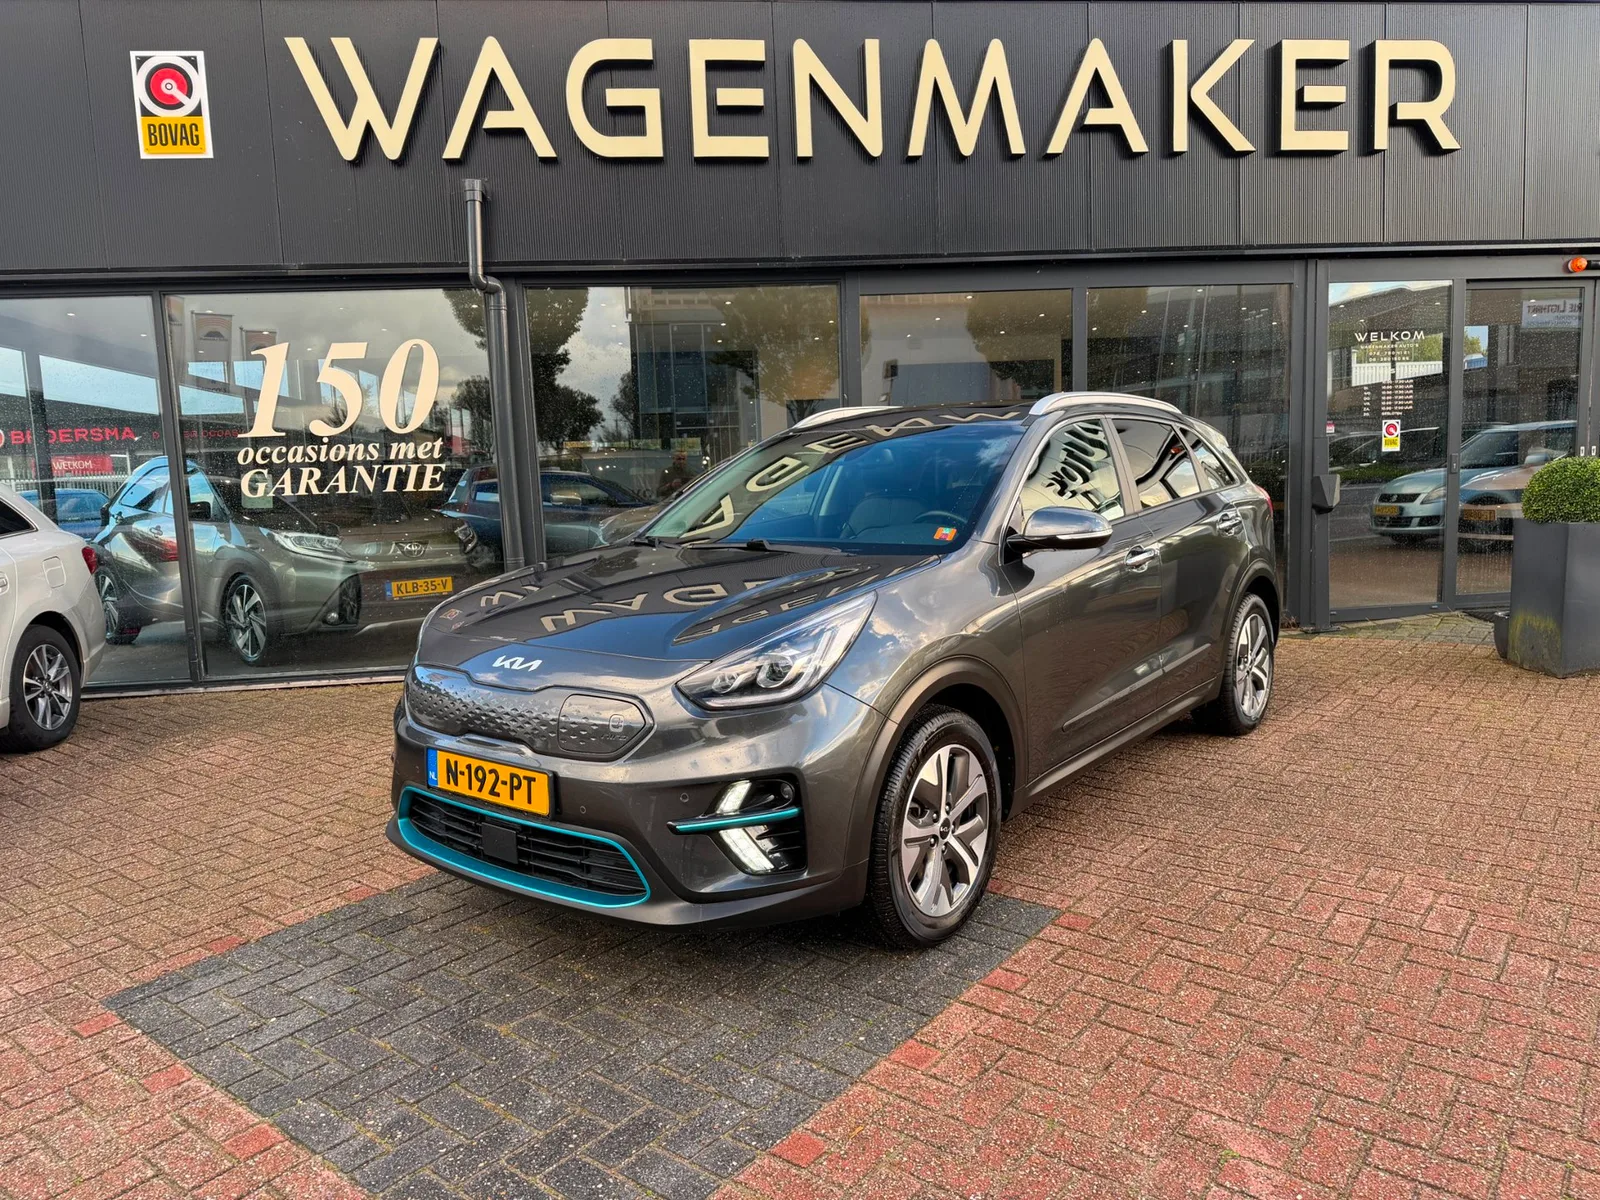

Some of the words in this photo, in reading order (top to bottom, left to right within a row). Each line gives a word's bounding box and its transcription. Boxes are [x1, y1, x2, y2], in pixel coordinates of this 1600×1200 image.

[284, 36, 1461, 162] WAGENMAKER
[147, 123, 200, 148] BOVAG
[1354, 330, 1425, 342] WELKOM
[237, 338, 439, 438] 150
[237, 436, 379, 465] occasions
[389, 436, 444, 460] met
[240, 463, 446, 498] GARANTIE
[396, 579, 448, 595] KLB-35-V
[492, 654, 543, 671] KIA
[445, 758, 537, 805] N-192-PT
